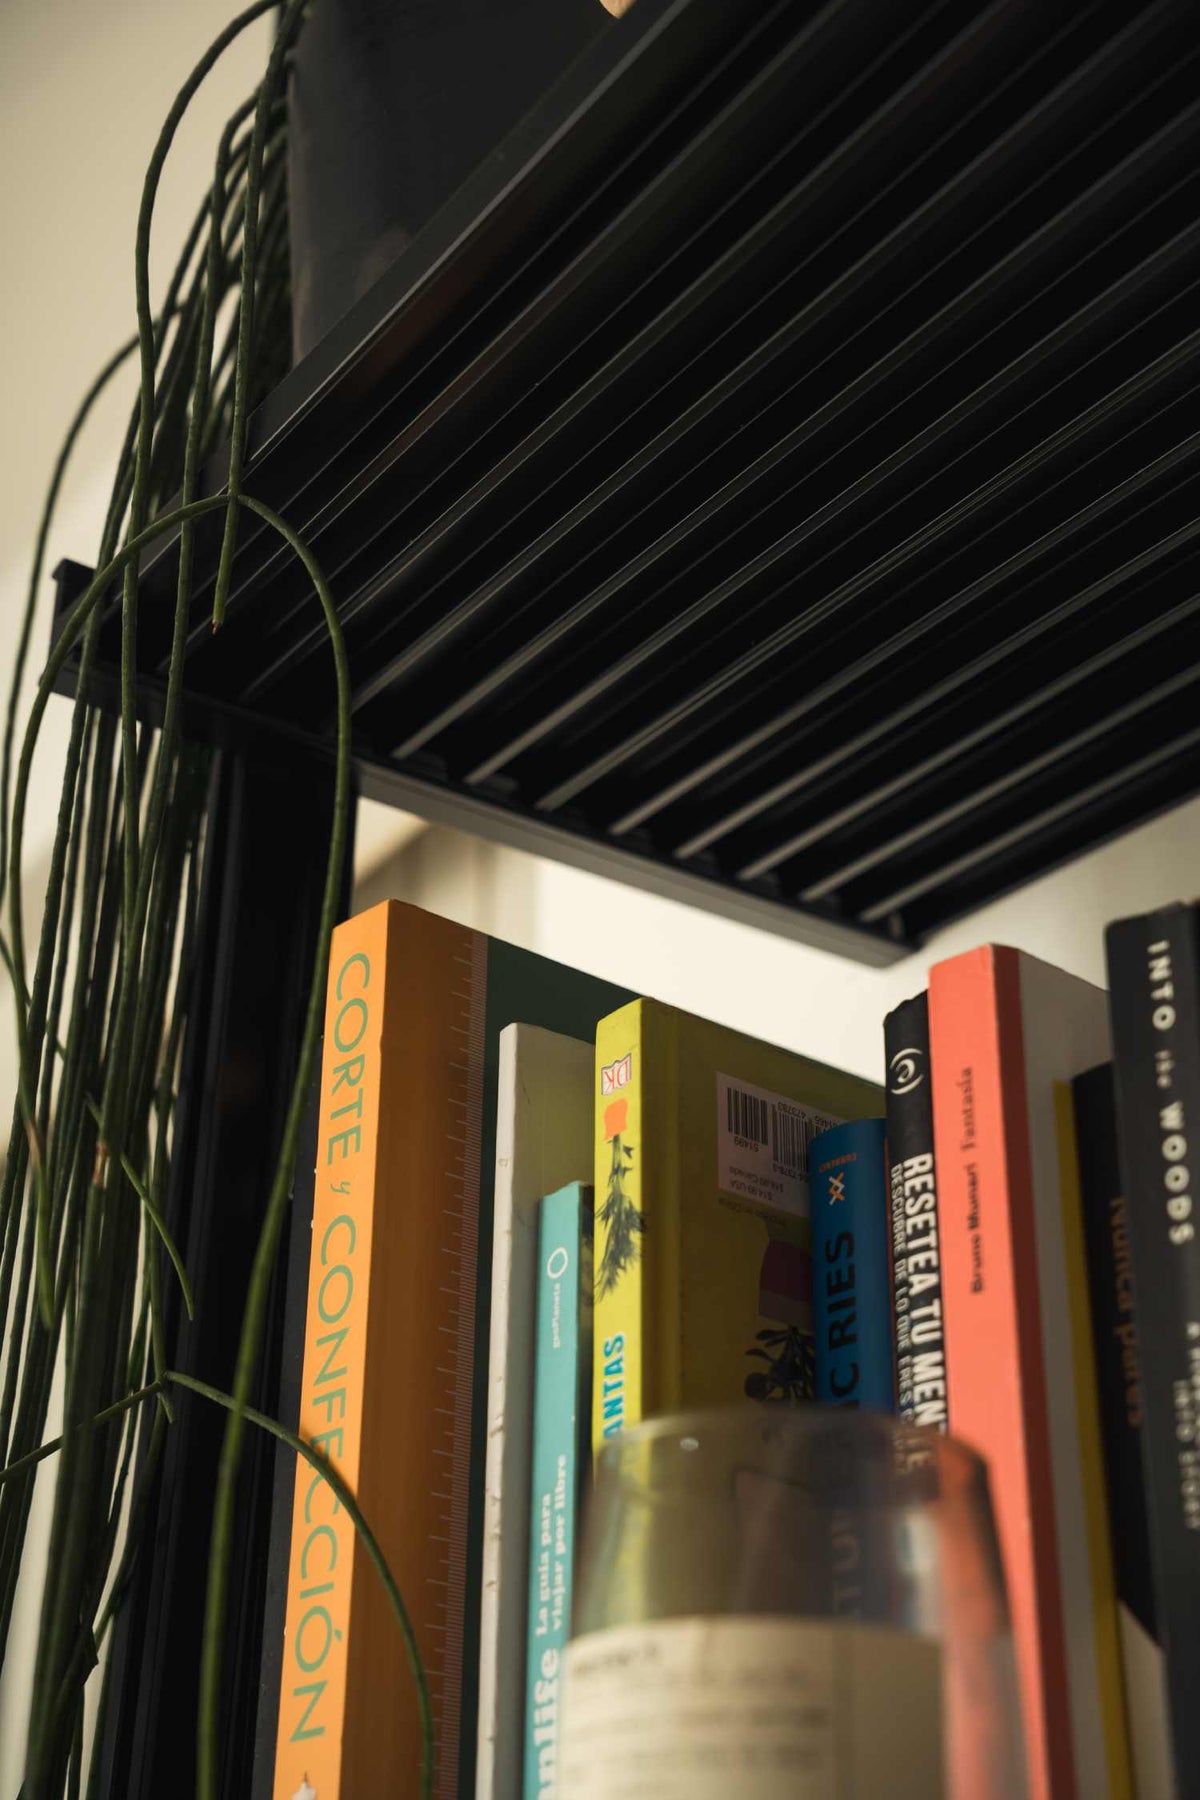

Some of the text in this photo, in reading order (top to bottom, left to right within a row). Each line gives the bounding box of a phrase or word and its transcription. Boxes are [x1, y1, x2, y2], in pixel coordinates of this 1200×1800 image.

[1147, 939, 1175, 1030] INTO
[604, 1060, 628, 1092] DK
[891, 1163, 907, 1254] DESCUBRE
[1160, 1101, 1194, 1245] WOODS
[903, 1152, 940, 1296] RESETEA
[826, 1230, 858, 1351] RIES
[910, 1298, 943, 1345] TU
[289, 952, 371, 1743] CORTE y CONFECCIÓN
[602, 1332, 625, 1440] ANTAS
[555, 1513, 566, 1555] por
